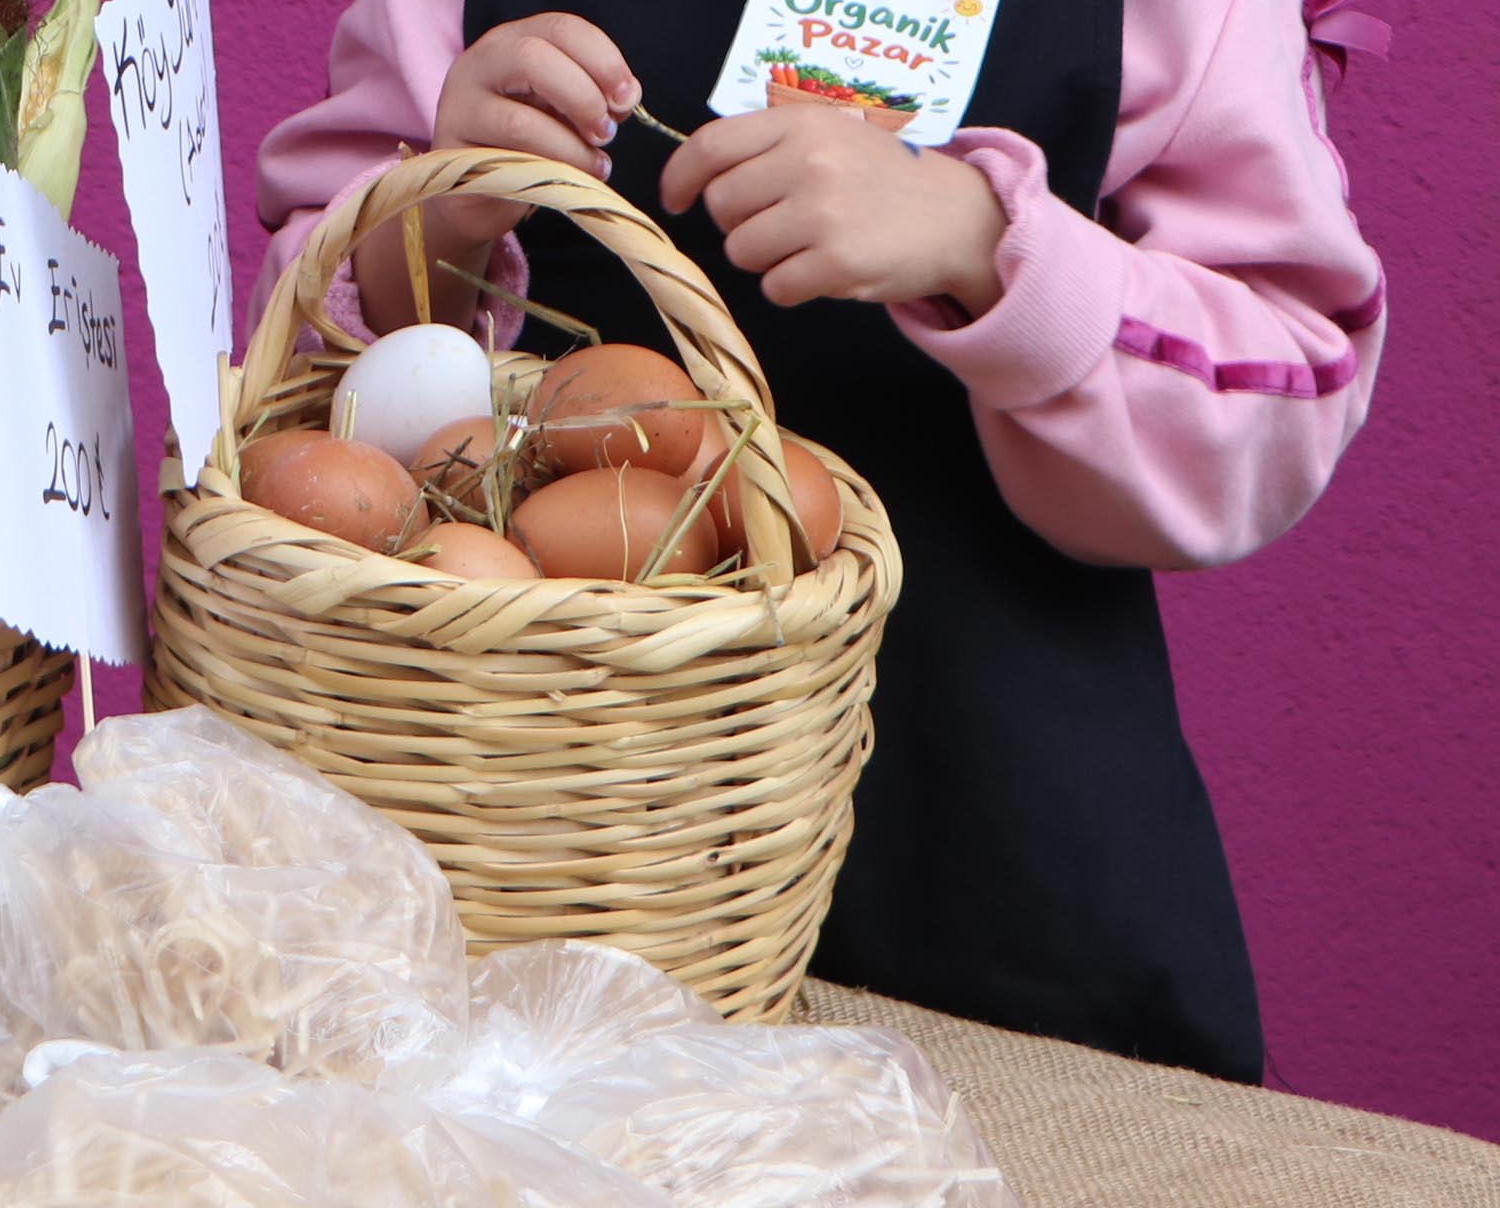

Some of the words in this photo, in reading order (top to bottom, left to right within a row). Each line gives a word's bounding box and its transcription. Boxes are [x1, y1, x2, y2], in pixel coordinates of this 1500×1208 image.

[112, 14, 173, 142] Köy
[797, 18, 934, 70] Pazar
[48, 257, 118, 370] Eriştesi
